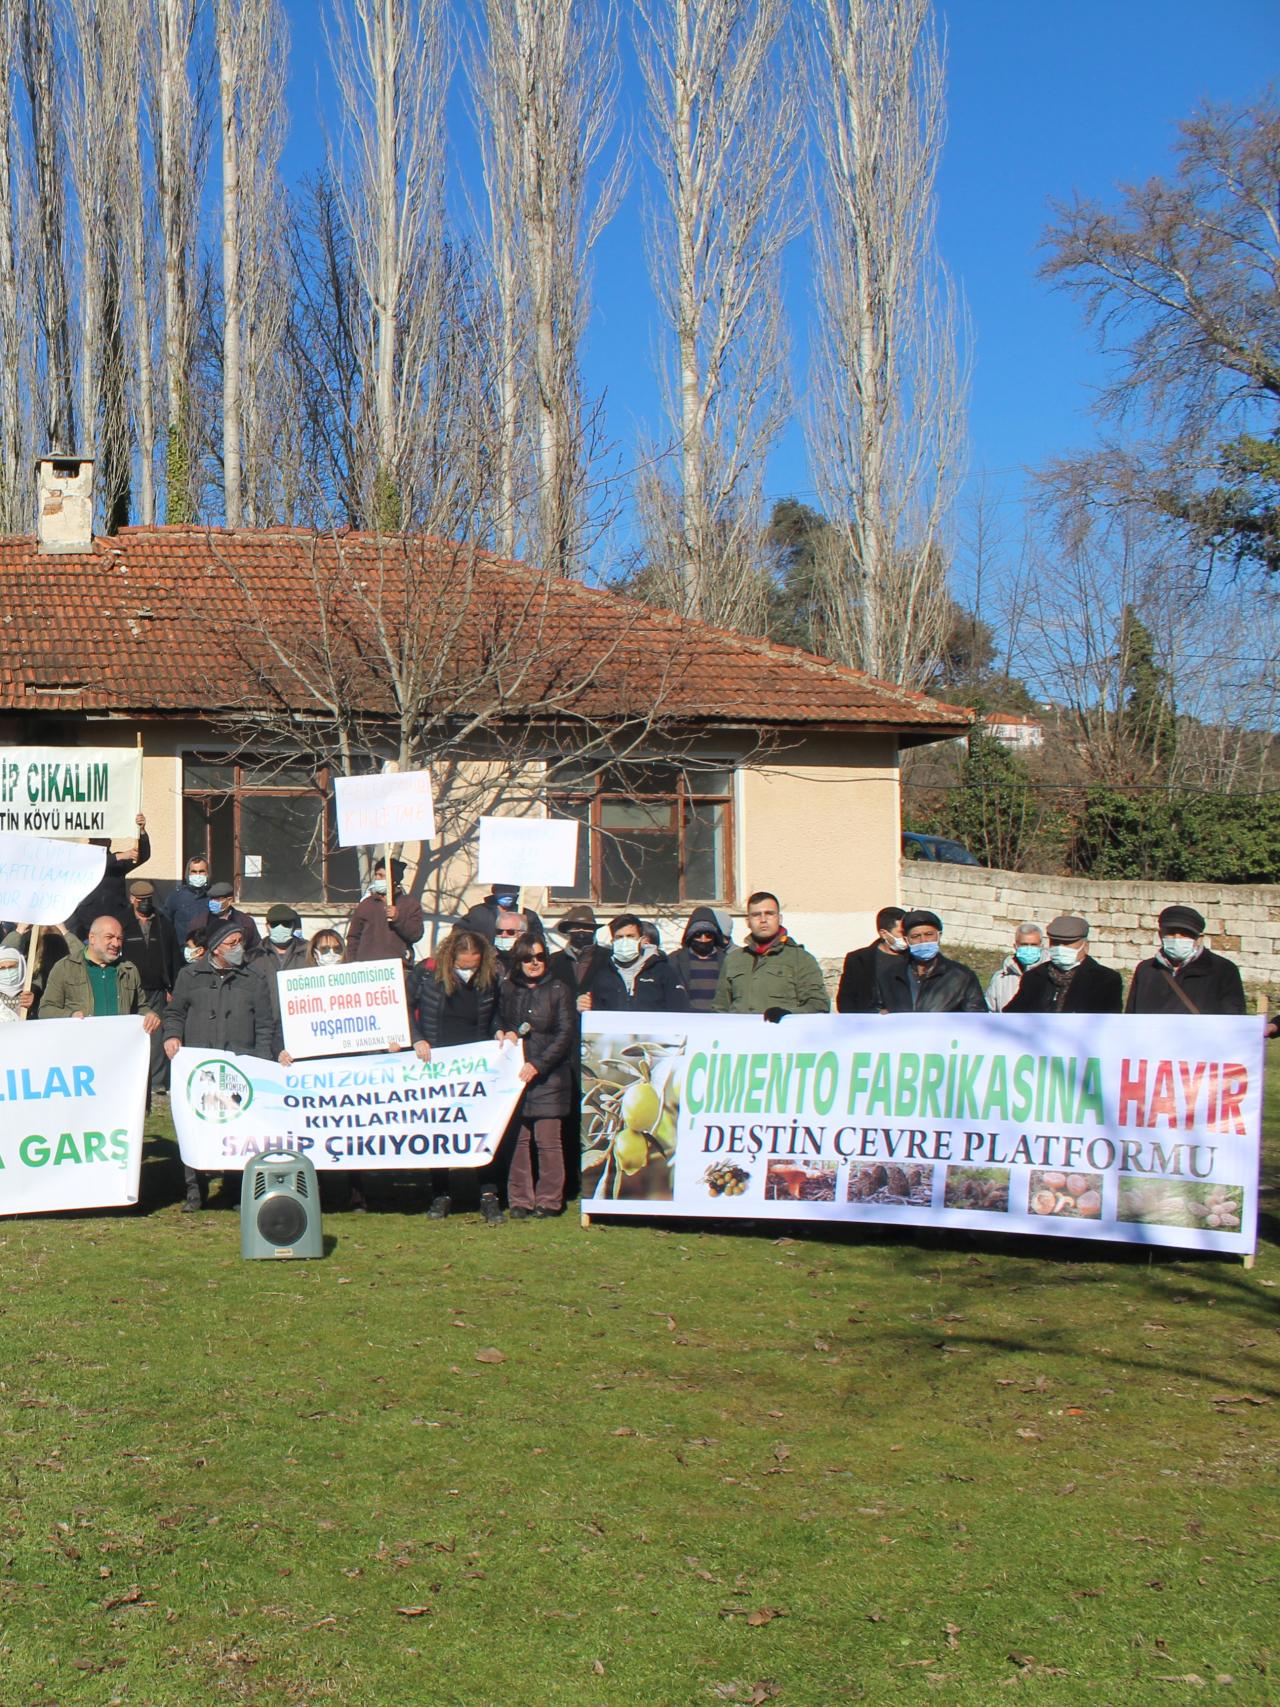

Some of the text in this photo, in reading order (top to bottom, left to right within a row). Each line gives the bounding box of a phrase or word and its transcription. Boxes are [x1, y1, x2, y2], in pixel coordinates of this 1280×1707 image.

[26, 762, 109, 806] ÇIKALIM
[24, 808, 61, 831] KÖYÜ
[65, 811, 105, 831] HALKI
[286, 966, 397, 992] DOĞANIN EKONOMİSİNDE
[287, 985, 400, 1016] BİRİM, PARA DEĞİL
[311, 1015, 382, 1040] YAŞAMDIR.
[355, 1036, 386, 1048] VANDANA
[401, 1055, 489, 1083] KARAYA
[283, 1081, 487, 1109] ORMANLARIMIZA
[684, 1040, 1250, 1136] ÇİMENTO FABRİKASINA HAYIR
[304, 1106, 469, 1129] KIYILARIMIZA
[220, 1127, 493, 1163] SAHİP ÇIKIYORUZ
[701, 1117, 1218, 1179] DEŞTİN ÇEVRE PLATFORMU
